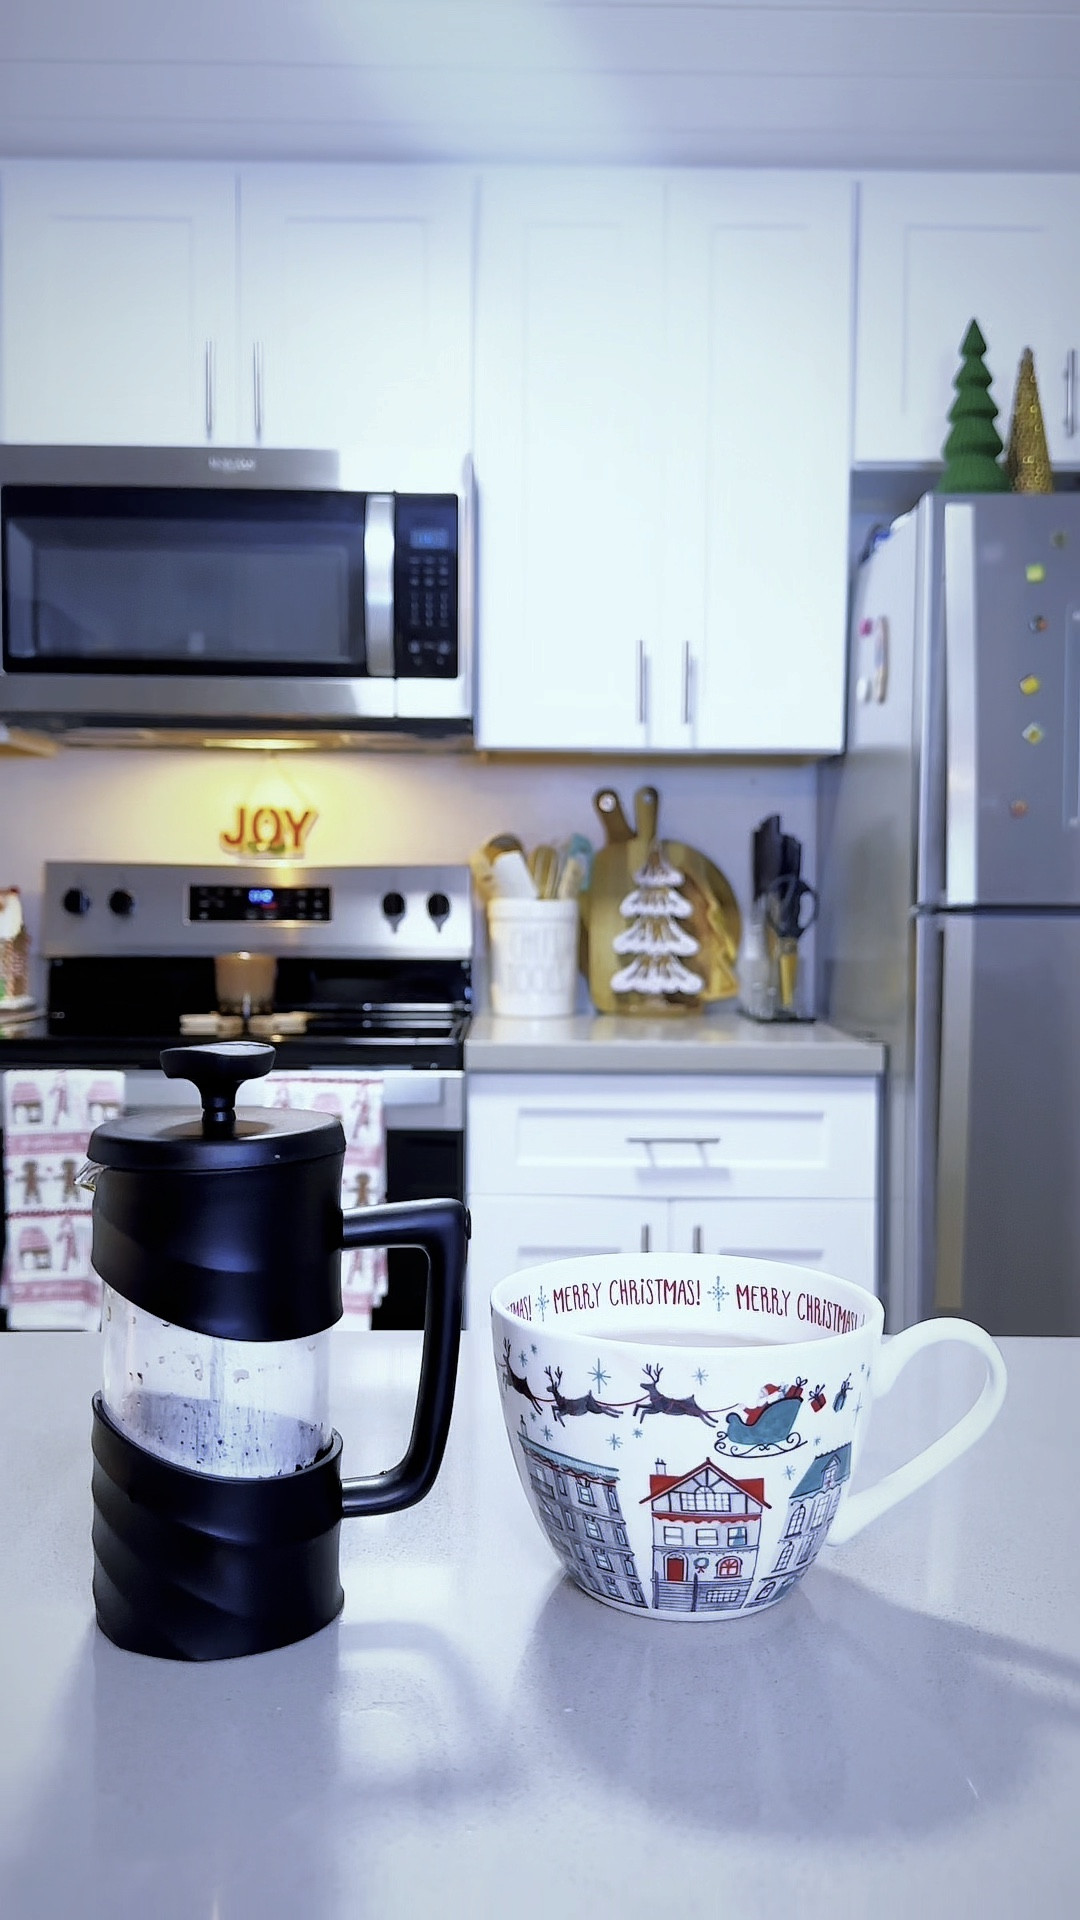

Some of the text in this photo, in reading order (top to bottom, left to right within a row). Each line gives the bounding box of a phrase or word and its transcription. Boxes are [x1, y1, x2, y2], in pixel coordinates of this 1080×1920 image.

[221, 805, 315, 851] JOY
[553, 1282, 602, 1314] MERRY
[735, 1283, 791, 1317] MERRY
